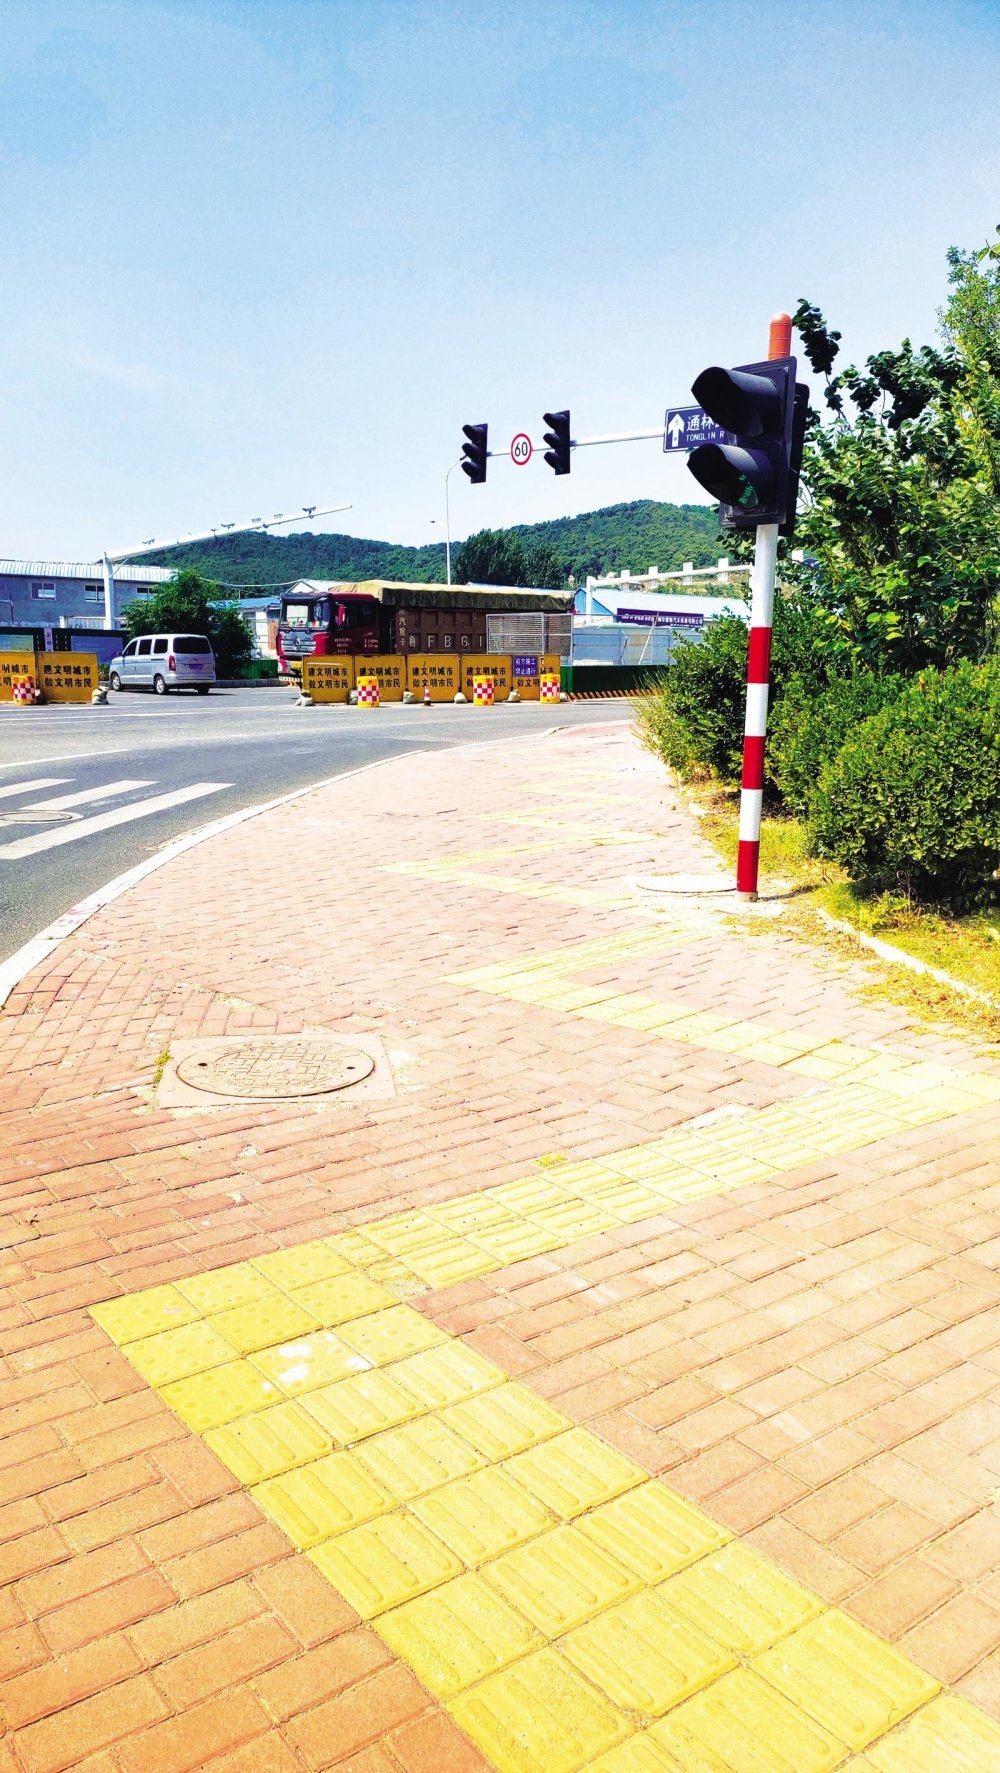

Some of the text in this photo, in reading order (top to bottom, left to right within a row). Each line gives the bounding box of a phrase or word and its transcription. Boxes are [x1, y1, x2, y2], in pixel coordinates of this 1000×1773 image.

[686, 412, 720, 431] 通林
[686, 431, 716, 442] TONGLIN
[514, 441, 528, 457] 60
[43, 665, 91, 675] 建文明城市
[308, 667, 348, 677] 建文明城市
[359, 667, 400, 676] 建文明城市
[412, 666, 454, 676] 建文明城市
[466, 666, 506, 676] 建文明城市
[44, 677, 92, 688] 做文明市民
[308, 679, 348, 689] 做文明市民
[412, 678, 454, 688] 做文明市民
